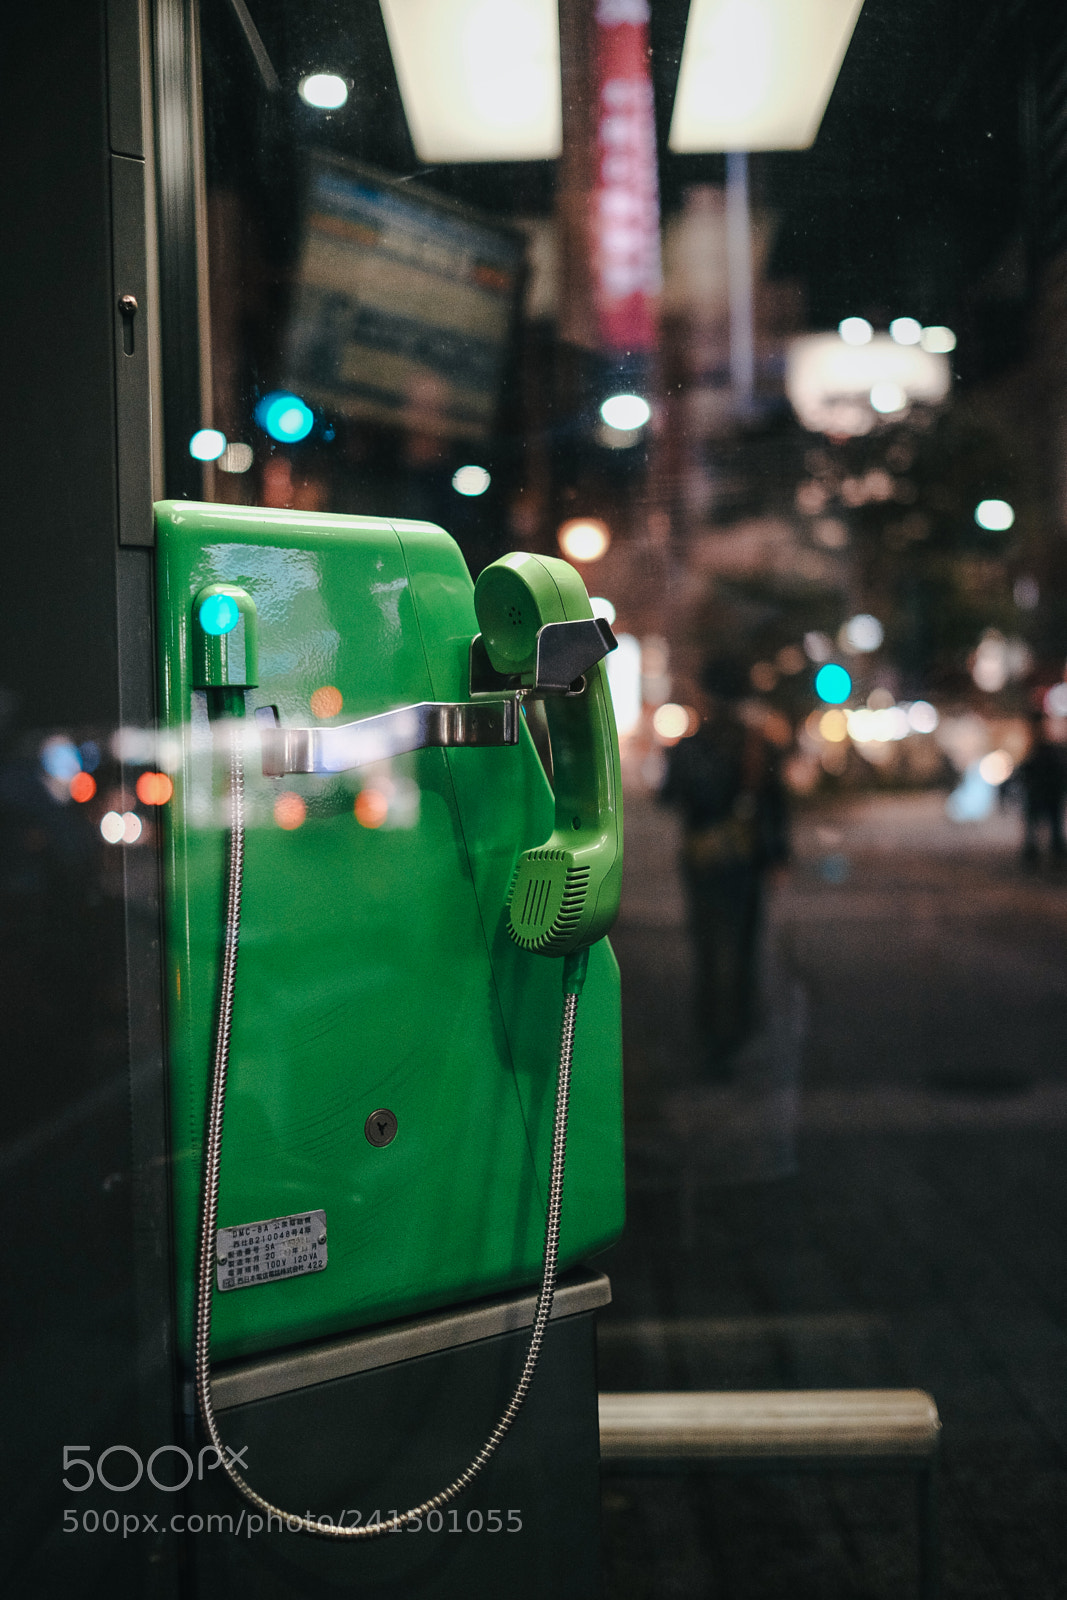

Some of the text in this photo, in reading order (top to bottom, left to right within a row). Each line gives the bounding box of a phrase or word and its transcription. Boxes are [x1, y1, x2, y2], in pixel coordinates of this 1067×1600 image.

[232, 1225, 269, 1238] DMC-8A
[265, 1252, 275, 1260] 20
[266, 1259, 286, 1269] 100V
[308, 1260, 323, 1269] 422
